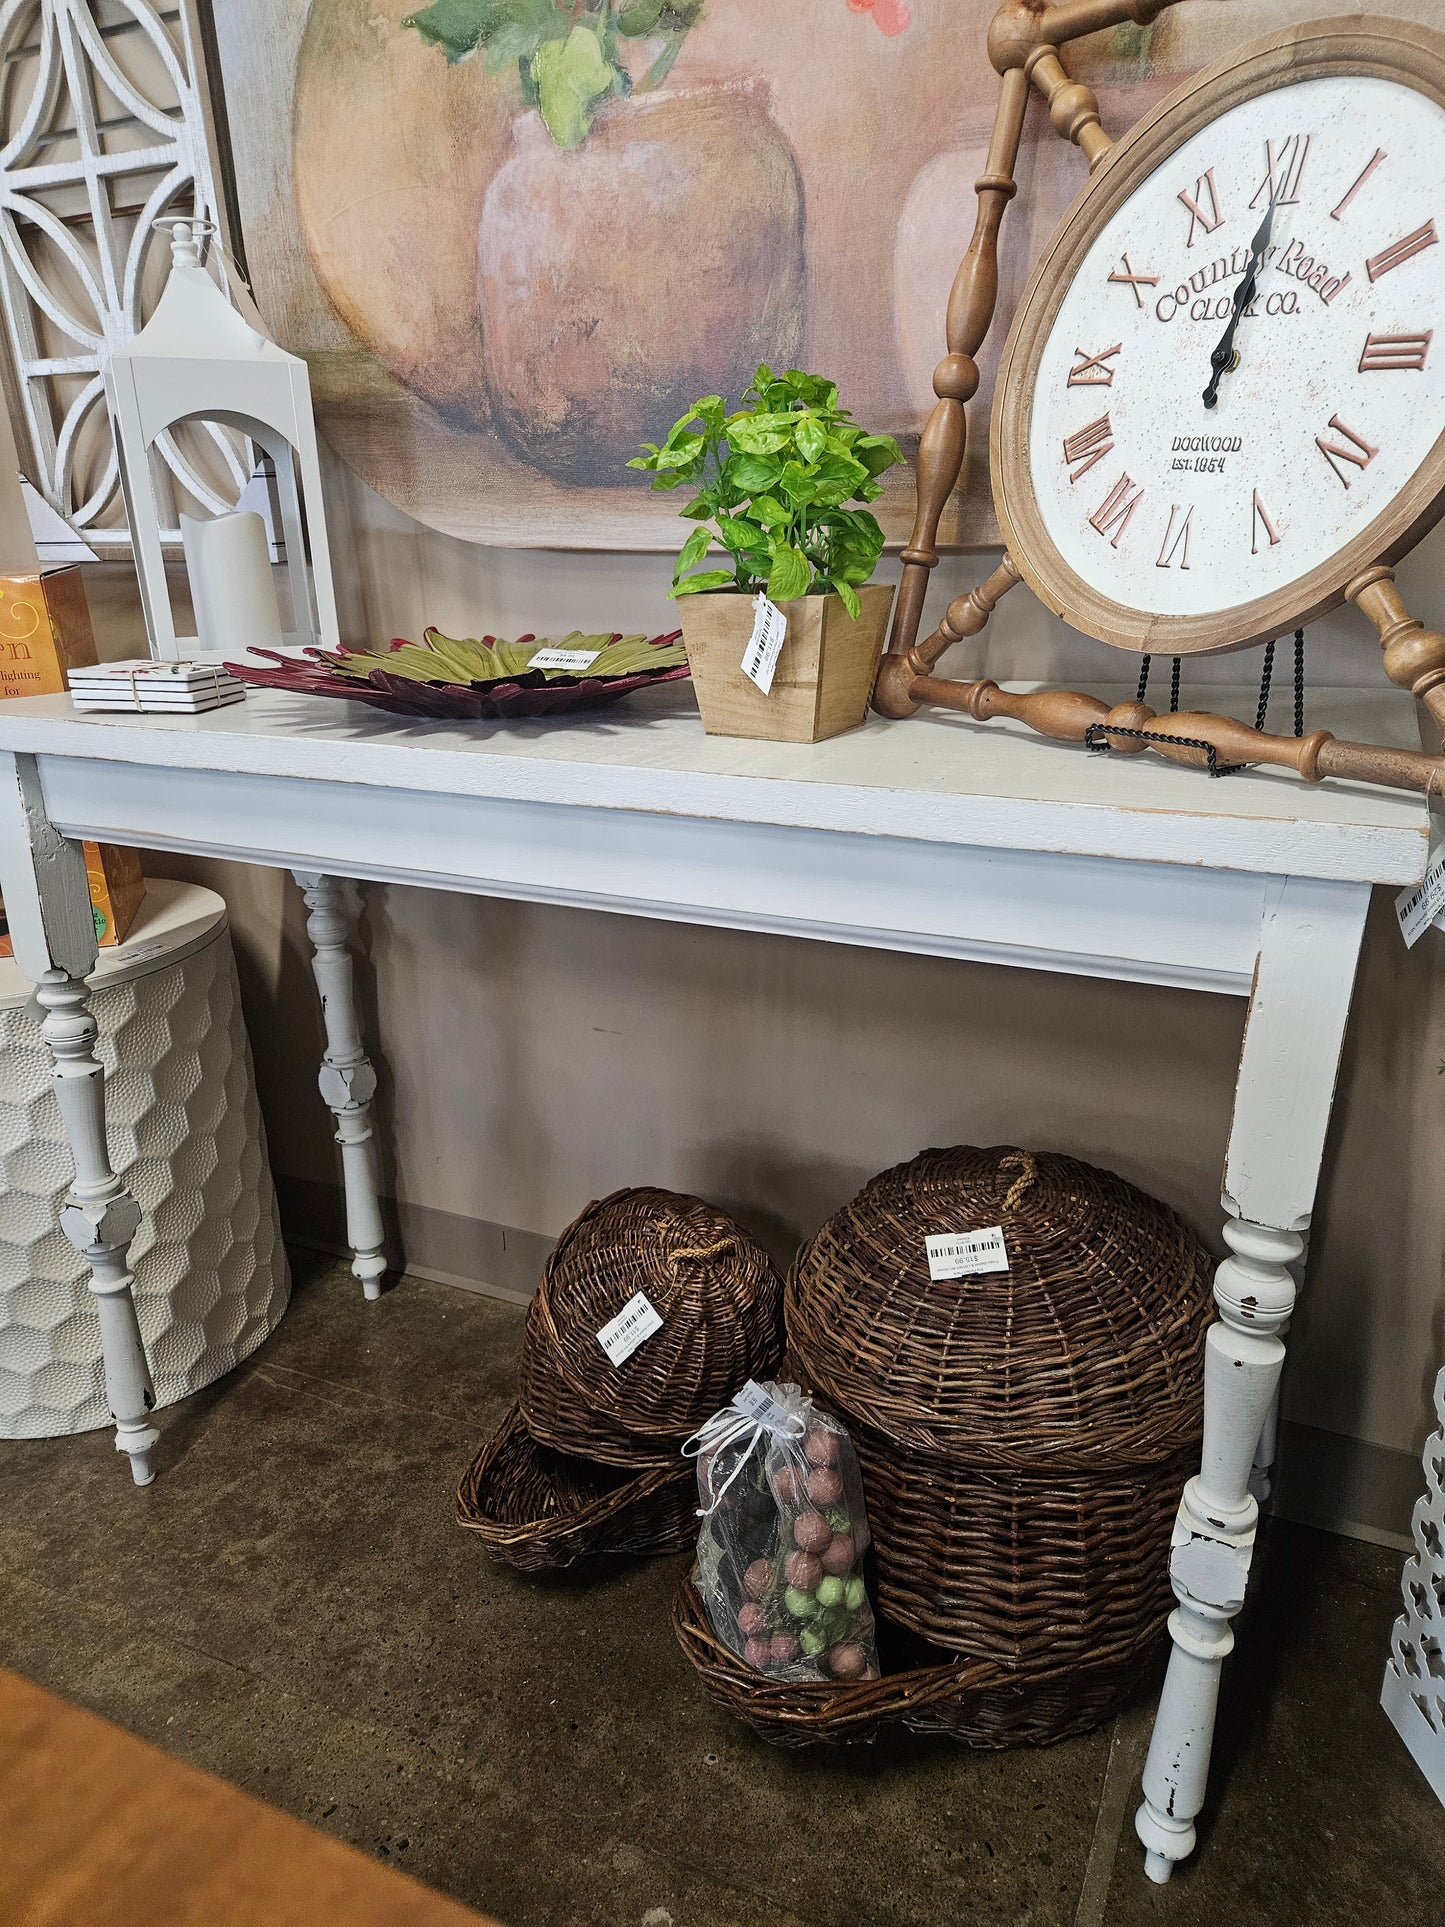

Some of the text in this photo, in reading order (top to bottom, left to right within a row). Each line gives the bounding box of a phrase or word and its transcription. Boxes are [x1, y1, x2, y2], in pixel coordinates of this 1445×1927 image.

[1250, 133, 1315, 210] XII
[1176, 166, 1226, 248] XI
[1107, 252, 1162, 309] X
[1275, 237, 1353, 307] Road
[1366, 217, 1440, 284] II
[1265, 290, 1302, 317] CO.
[1066, 342, 1123, 389] IX
[1358, 328, 1434, 374] III
[1062, 410, 1116, 485] VIII
[1171, 435, 1243, 452] DOGWOOD
[1314, 412, 1381, 490] IV
[1088, 470, 1146, 550] VII
[1155, 503, 1196, 570] VI
[1250, 487, 1282, 555] V
[0, 669, 42, 683] lighting
[4, 685, 22, 696] for
[1421, 883, 1442, 911] $29.99
[954, 1255, 979, 1265] $15.99
